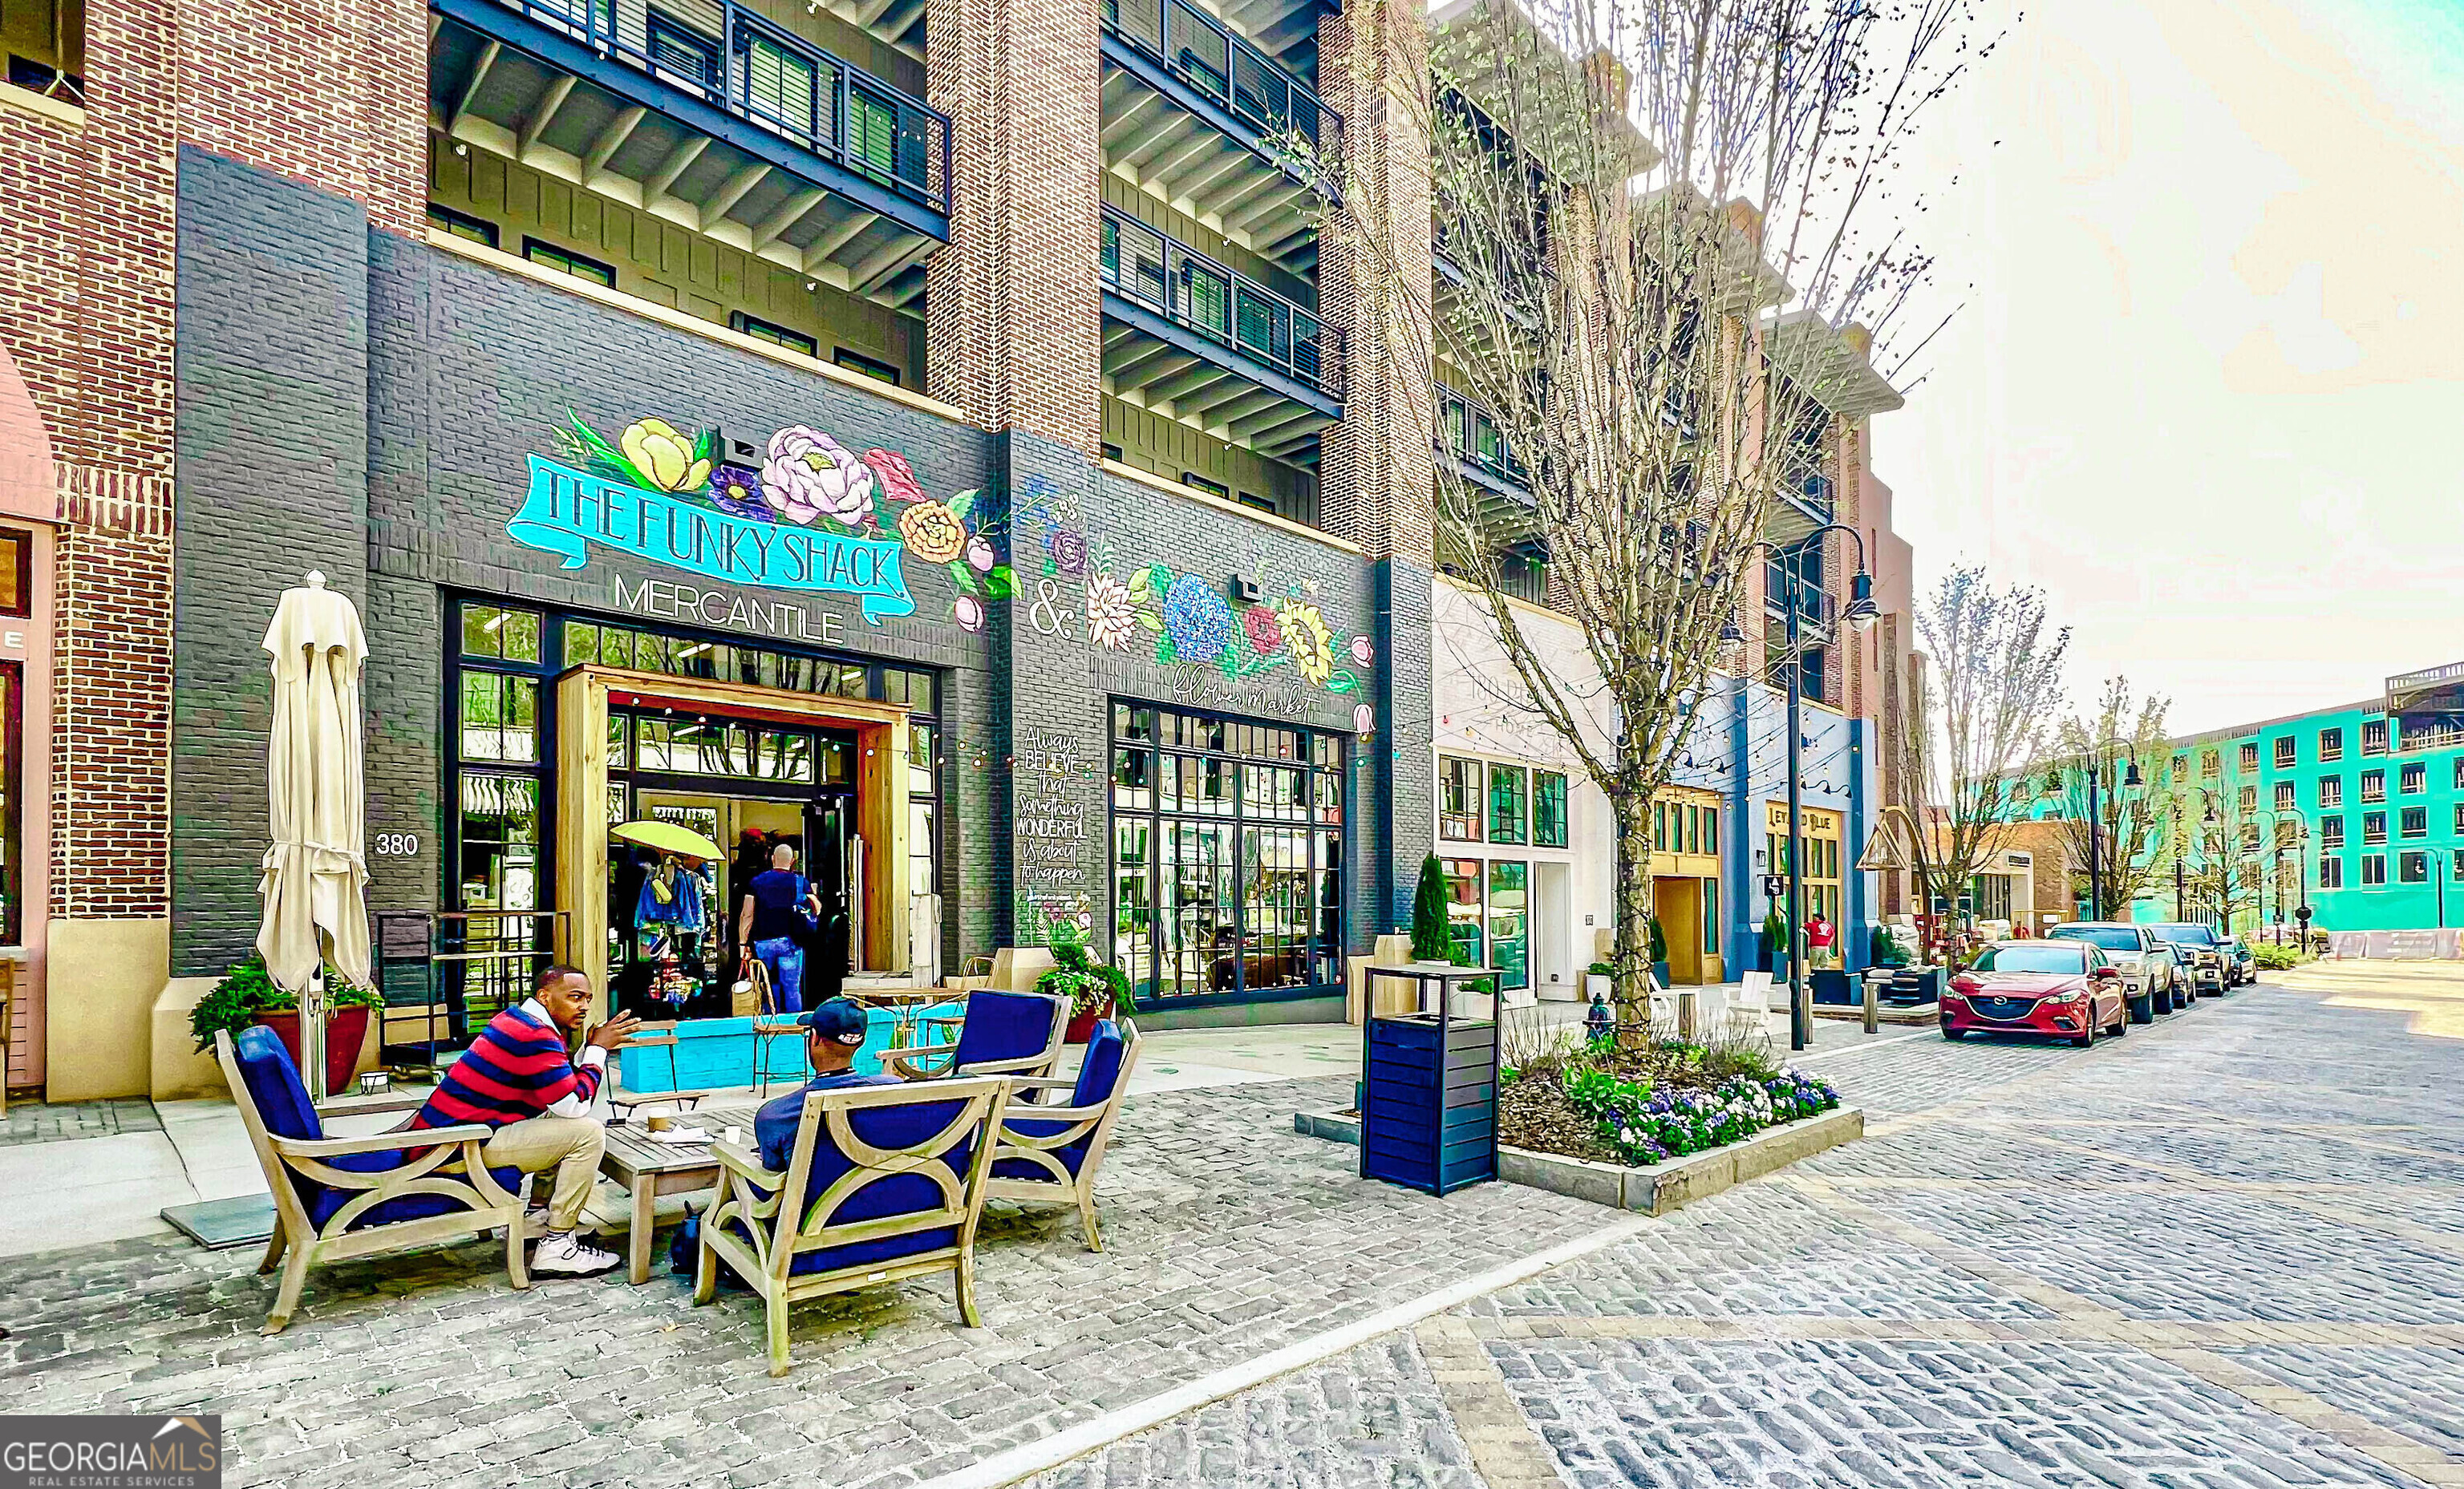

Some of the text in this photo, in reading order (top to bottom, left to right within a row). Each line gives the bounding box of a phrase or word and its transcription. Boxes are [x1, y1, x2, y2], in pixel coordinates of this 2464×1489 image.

[545, 467, 905, 598] THE FUNKY SHACK
[614, 573, 845, 645] MERCANTILE
[1028, 577, 1076, 641] &
[1023, 726, 1079, 759] Always
[1025, 749, 1080, 774] BELIEVE
[1032, 770, 1077, 800] that
[1015, 816, 1088, 840] WONDERFUL
[375, 833, 419, 856] 380
[1023, 837, 1082, 866] is about
[1019, 861, 1086, 888] to happen
